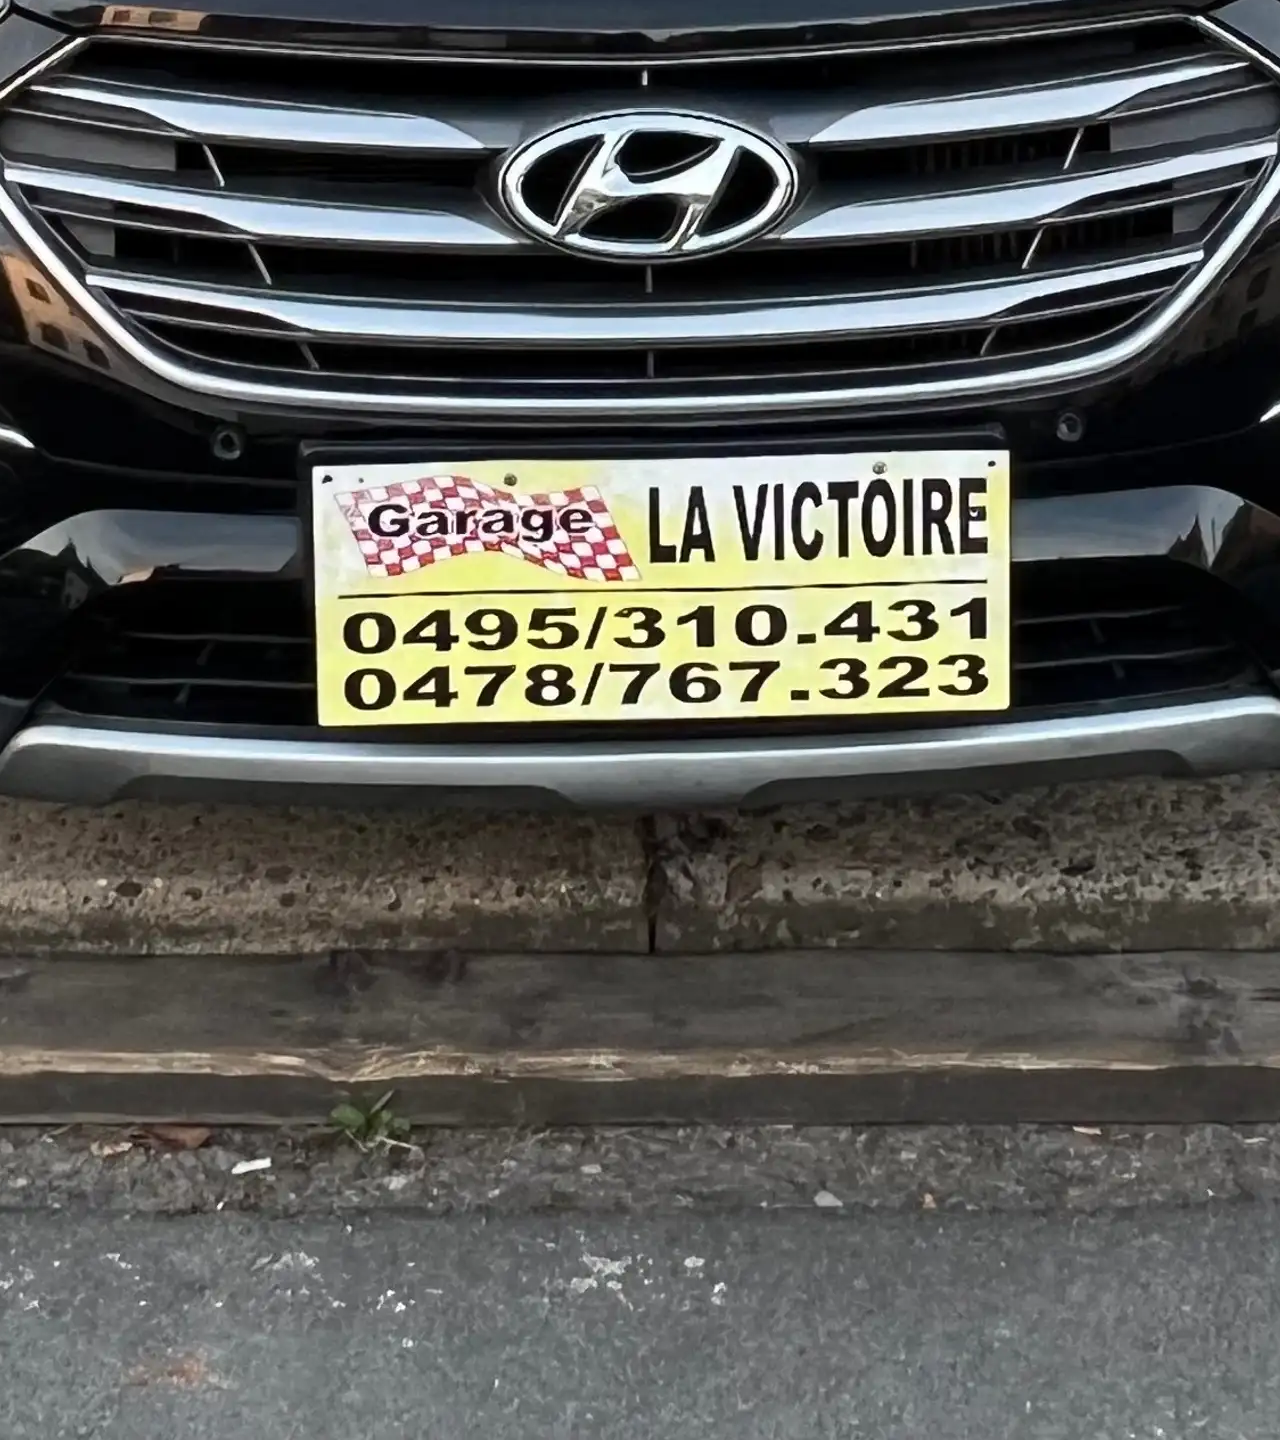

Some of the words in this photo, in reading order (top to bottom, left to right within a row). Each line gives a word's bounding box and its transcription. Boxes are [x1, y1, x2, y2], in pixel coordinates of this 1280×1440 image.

[367, 503, 594, 544] Garage
[649, 485, 716, 564] LA
[732, 477, 989, 562] VICTOIRE
[341, 596, 989, 654] 0495/310.431
[342, 653, 991, 711] 0478/767.323
